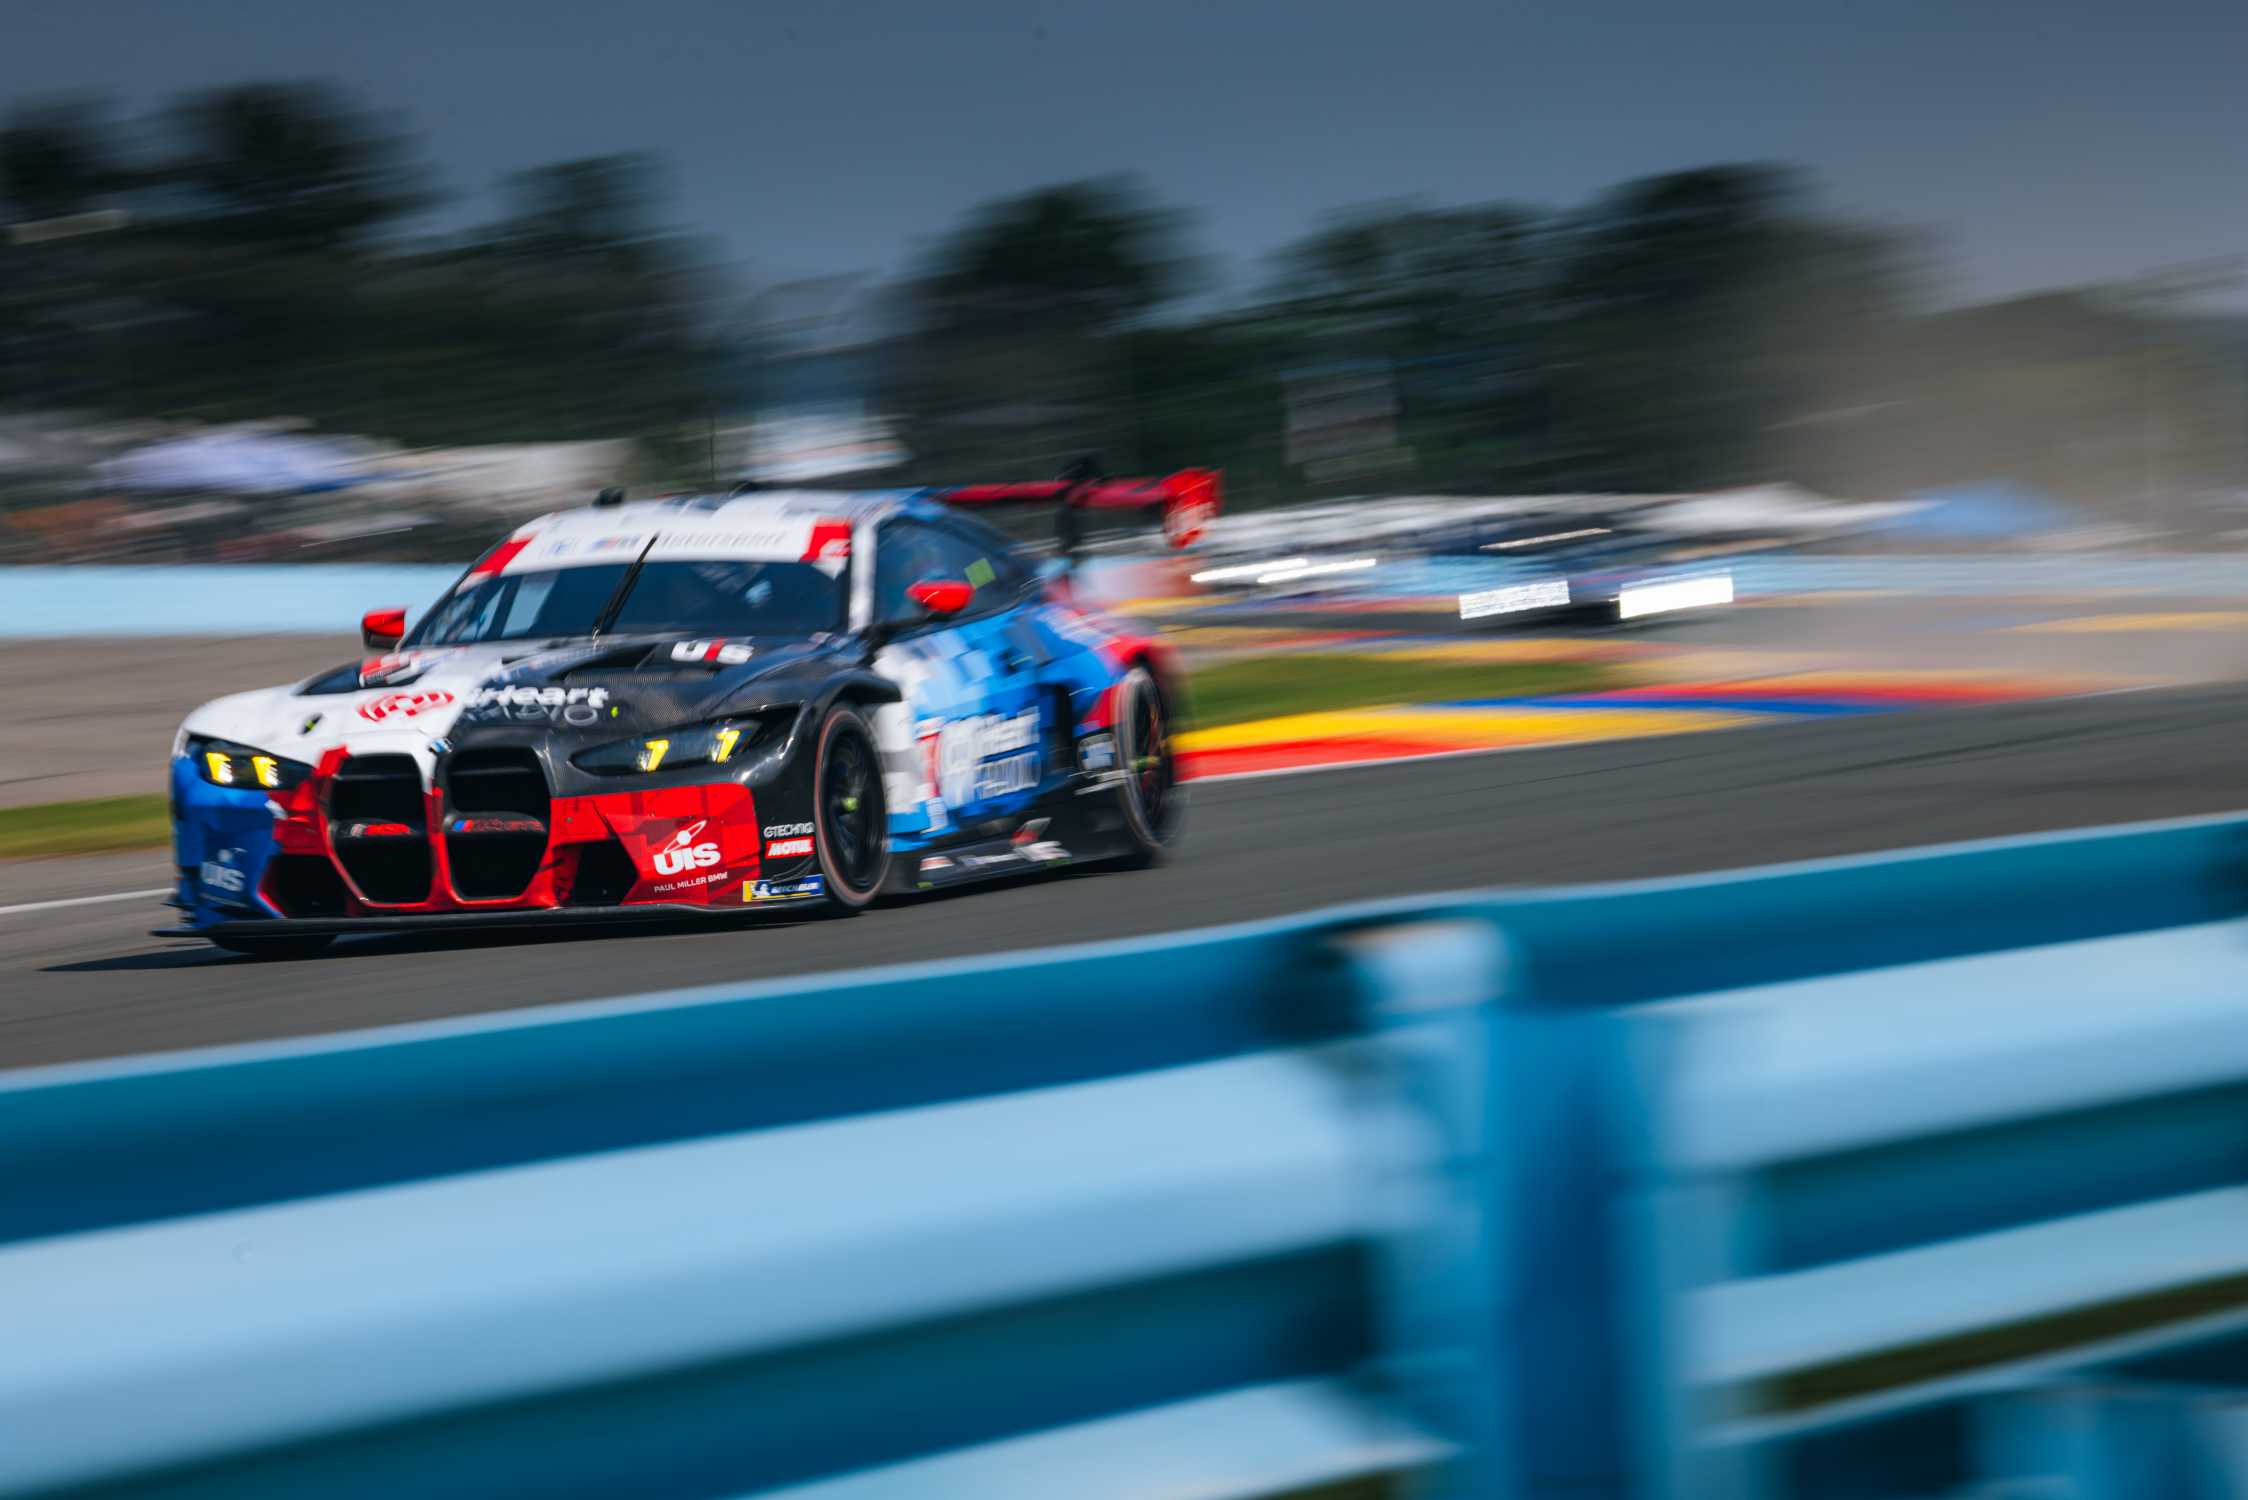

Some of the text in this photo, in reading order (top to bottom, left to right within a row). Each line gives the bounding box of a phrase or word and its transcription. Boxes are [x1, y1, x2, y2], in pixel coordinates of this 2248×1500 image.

[653, 842, 721, 876] UIS
[653, 870, 729, 894] PAUL MILLER BMW
